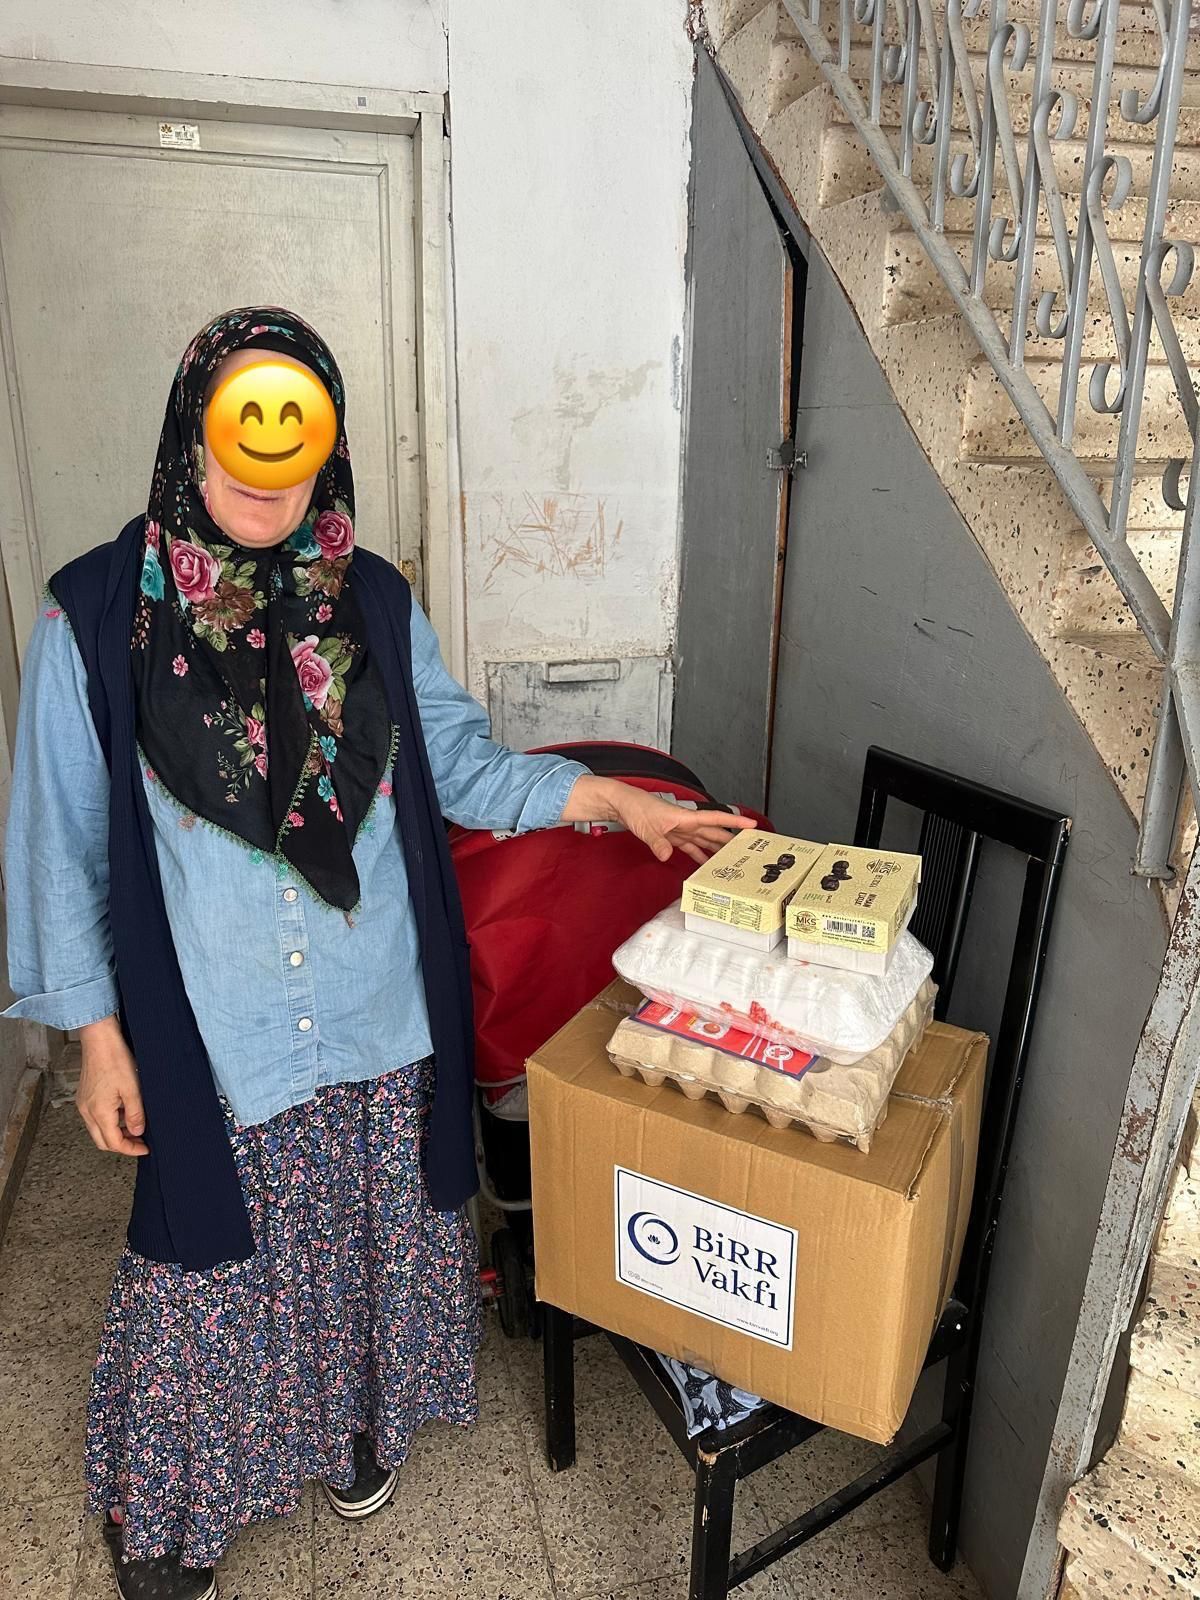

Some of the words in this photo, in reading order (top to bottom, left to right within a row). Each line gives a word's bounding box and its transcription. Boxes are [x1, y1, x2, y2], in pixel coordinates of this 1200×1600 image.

[796, 915, 817, 926] MKS
[693, 1225, 780, 1280] BiRR
[691, 1256, 778, 1310] Vakfı
